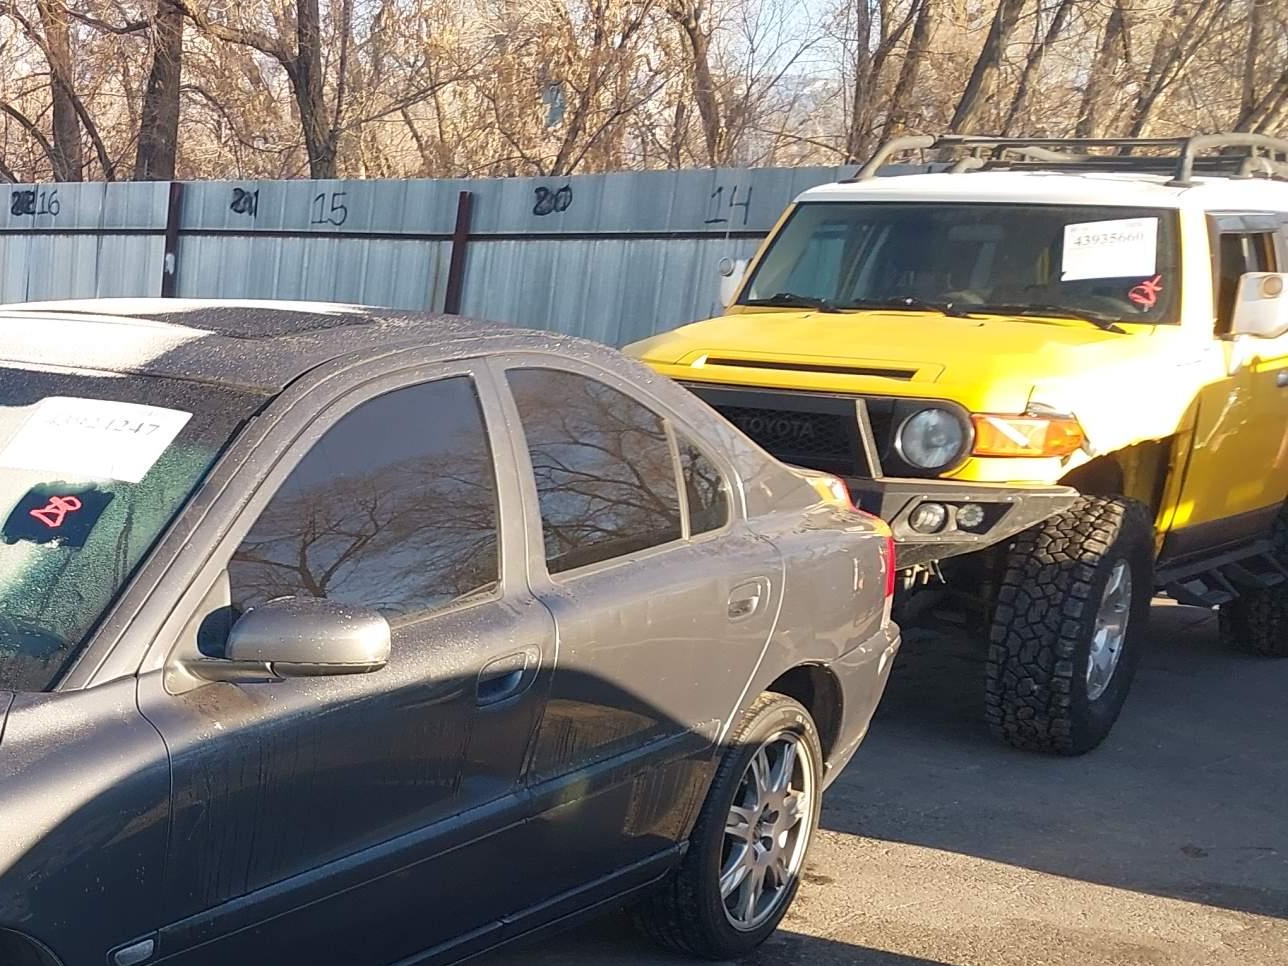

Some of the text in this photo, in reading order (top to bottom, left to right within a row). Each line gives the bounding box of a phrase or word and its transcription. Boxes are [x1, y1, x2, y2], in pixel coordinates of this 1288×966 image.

[37, 189, 60, 216] 16
[311, 192, 348, 226] 15
[704, 185, 753, 225] 14
[739, 417, 815, 440] TOYOTA
